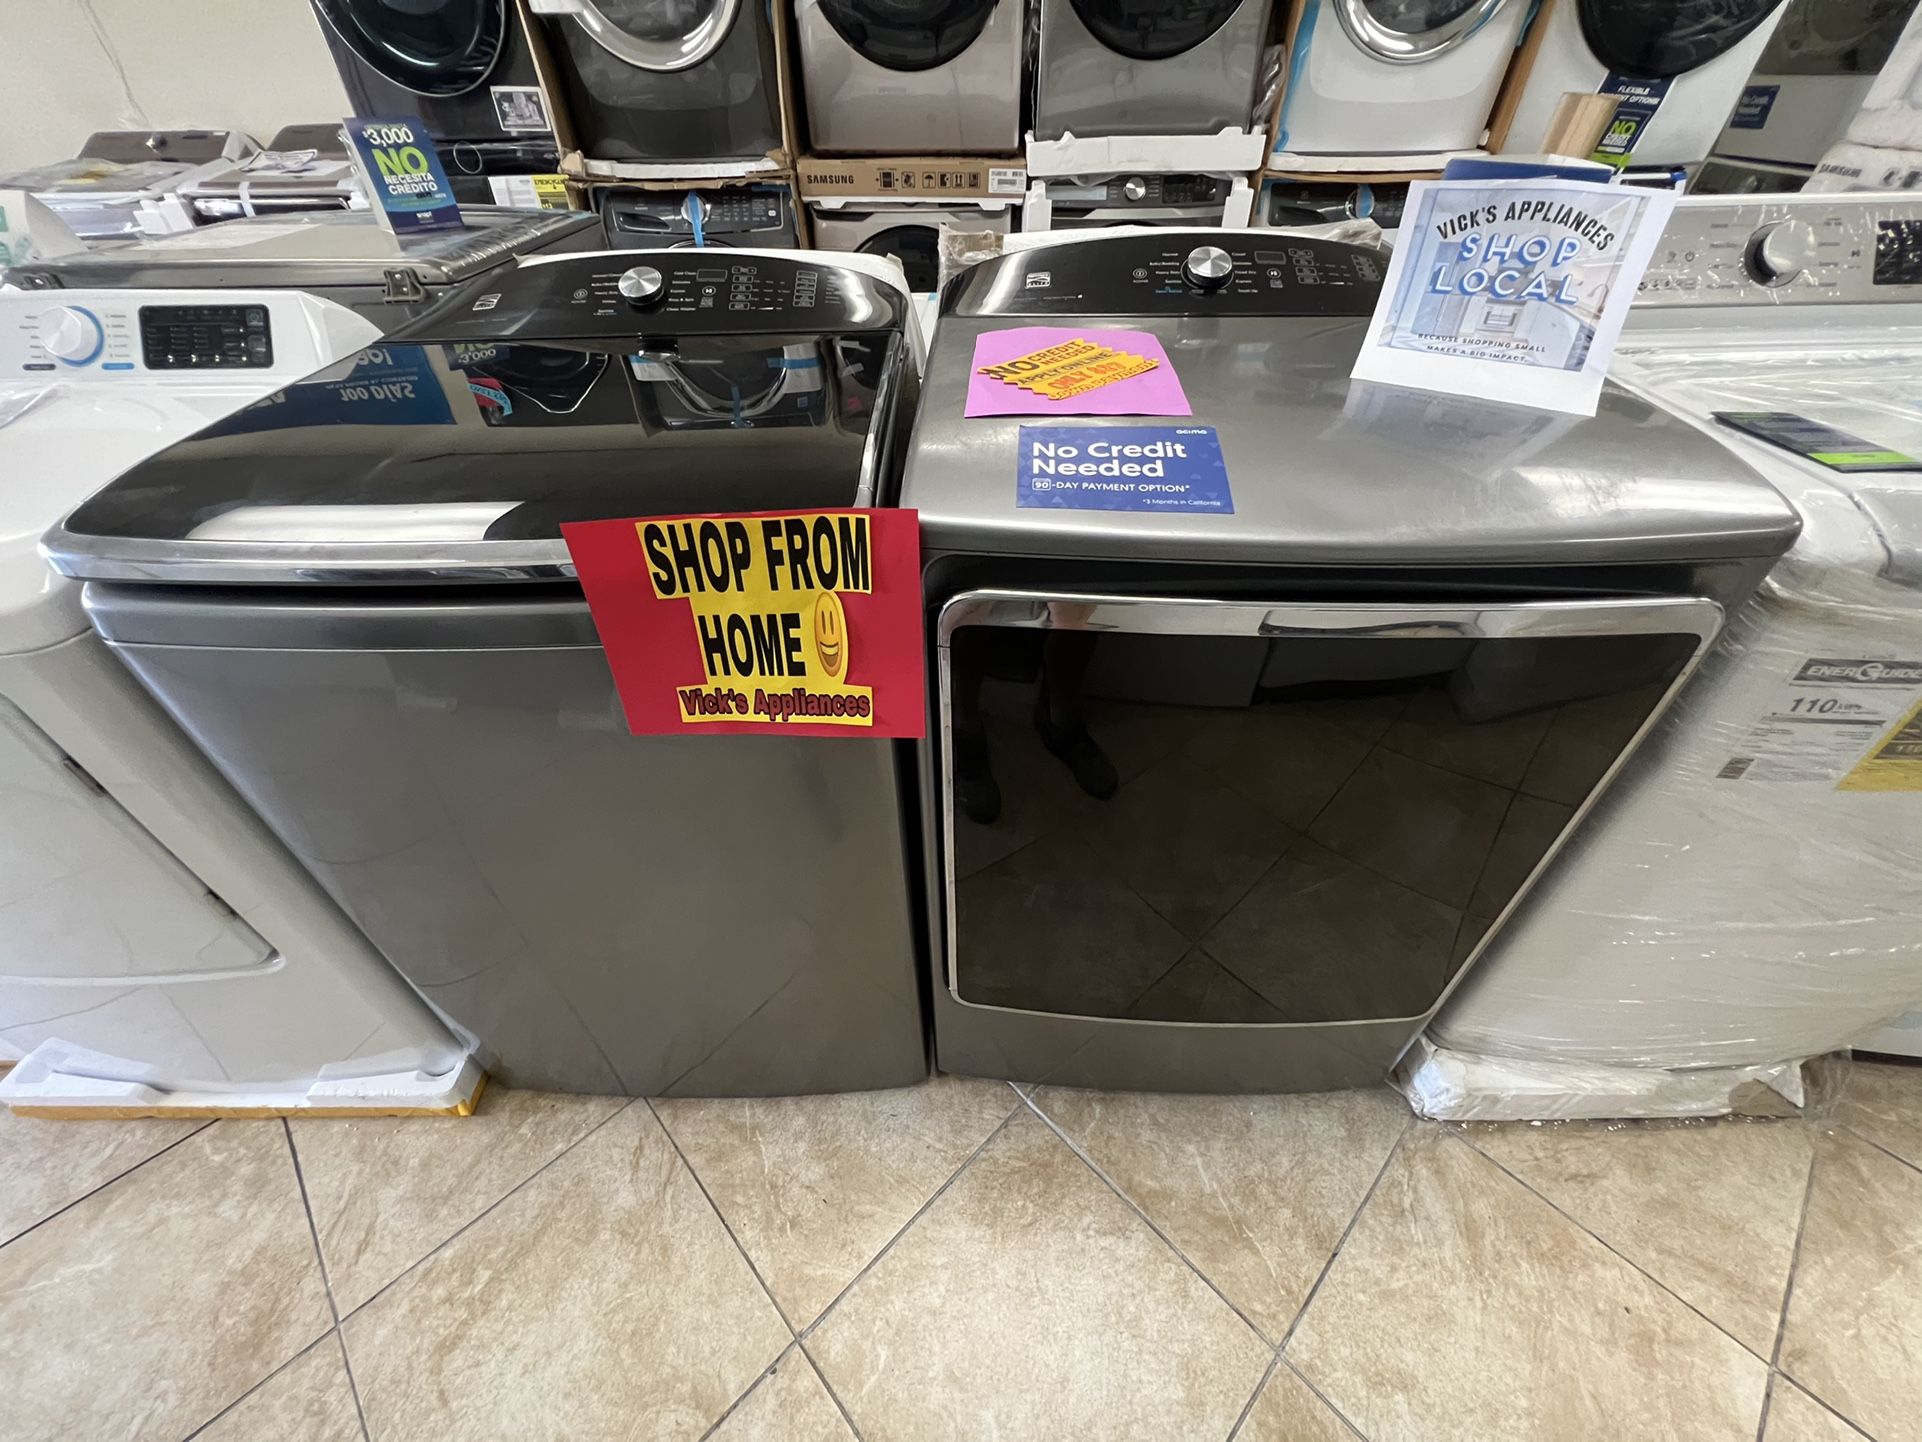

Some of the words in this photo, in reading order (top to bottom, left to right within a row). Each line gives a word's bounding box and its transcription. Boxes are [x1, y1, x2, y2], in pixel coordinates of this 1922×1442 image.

[1611, 119, 1637, 136] NO
[371, 146, 428, 176] NO
[383, 172, 435, 185] NECESITA
[807, 175, 854, 184] SAMSUNG
[1436, 205, 1498, 240] VICK'S
[1504, 200, 1615, 251] APPLIANCES
[1458, 233, 1582, 267] SHOP
[1430, 265, 1579, 304] LOCAL
[1418, 333, 1458, 343] BECAUSE
[1462, 338, 1511, 349] SHOPPING
[1515, 343, 1546, 353] SMALL
[1427, 345, 1457, 354] MAKES
[981, 361, 1039, 377] NO
[1028, 341, 1082, 362] CREDIT
[1040, 345, 1095, 366] NEEDED
[1018, 365, 1061, 385] APPLY
[1060, 351, 1112, 372] ONLINE
[1047, 370, 1093, 389] ONLY
[1033, 442, 1079, 458] No
[1087, 442, 1188, 458] Credit
[1032, 459, 1165, 477] Needed
[1082, 482, 1135, 492] PAYMENT
[643, 520, 752, 596] SHOP
[761, 516, 870, 592] FROM
[697, 613, 807, 677] HOME
[679, 687, 749, 717] Vick's
[753, 687, 871, 723] Appliances
[1790, 698, 1838, 713] 110
